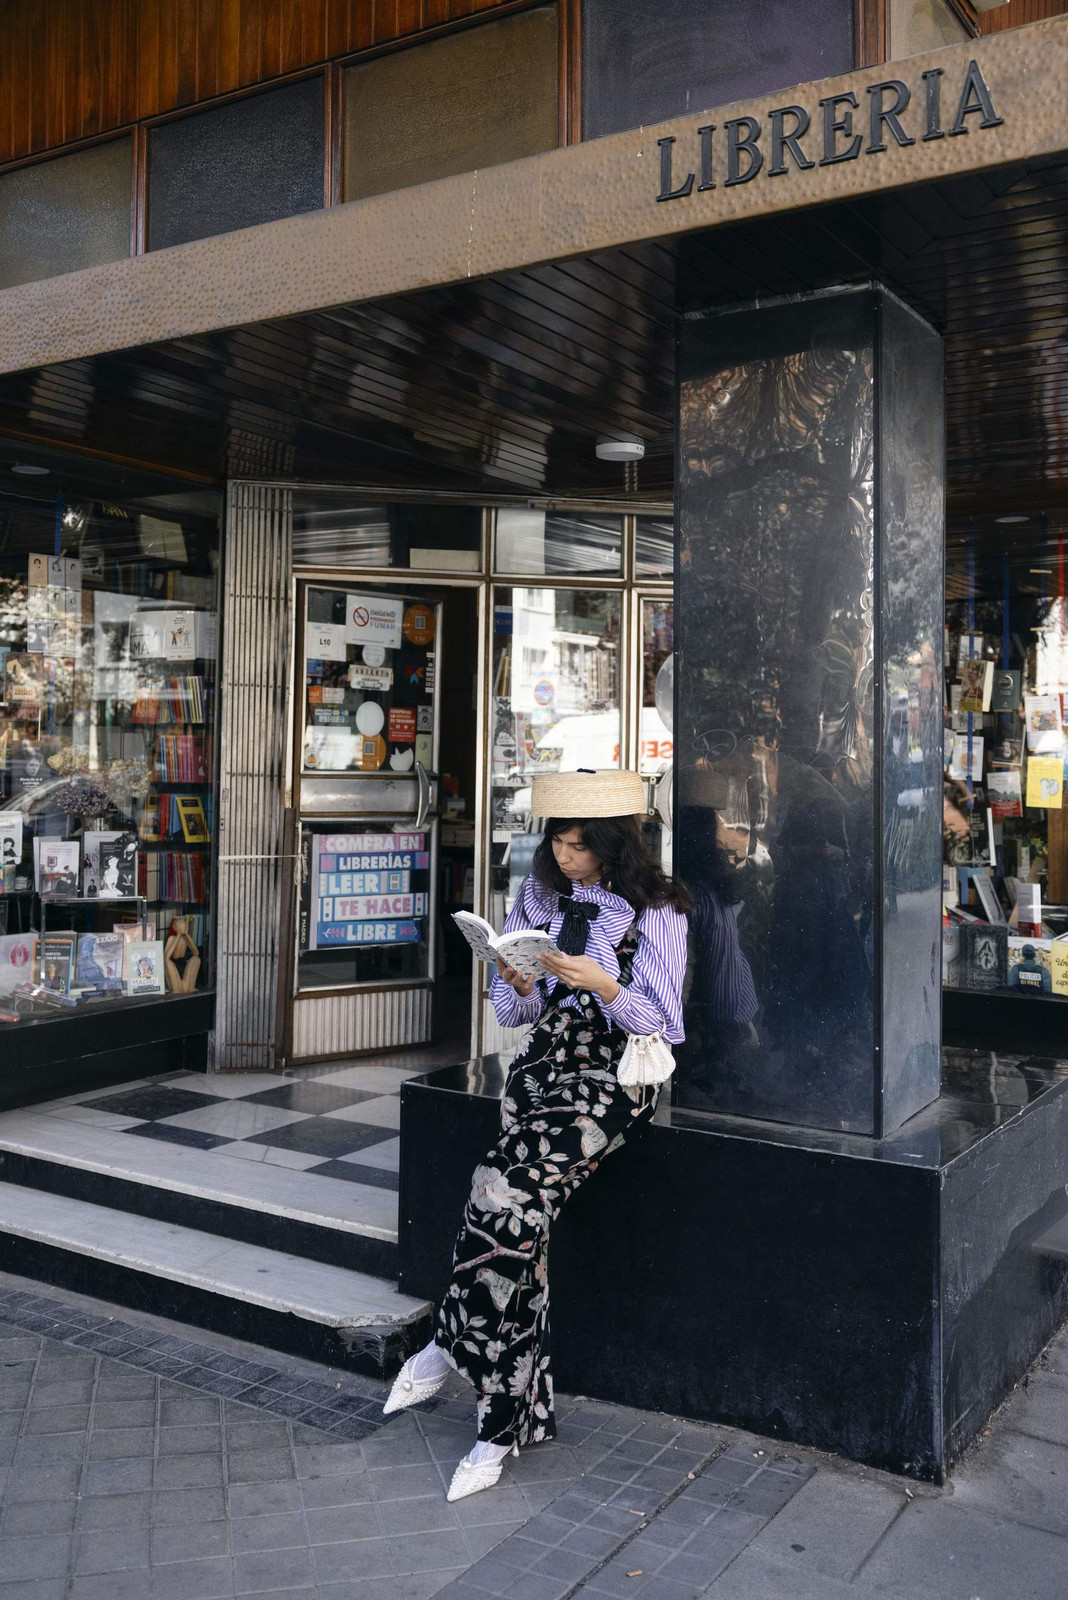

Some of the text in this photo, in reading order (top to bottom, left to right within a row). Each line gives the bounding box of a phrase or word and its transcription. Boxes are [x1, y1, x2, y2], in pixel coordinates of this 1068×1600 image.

[656, 59, 1004, 203] LIBRERIA
[325, 835, 420, 852] COMPRA EN
[339, 853, 412, 871] LIBRERÍAS
[328, 873, 379, 895] LEER
[339, 897, 411, 917] TE HACE
[346, 923, 397, 942] LIBRE
